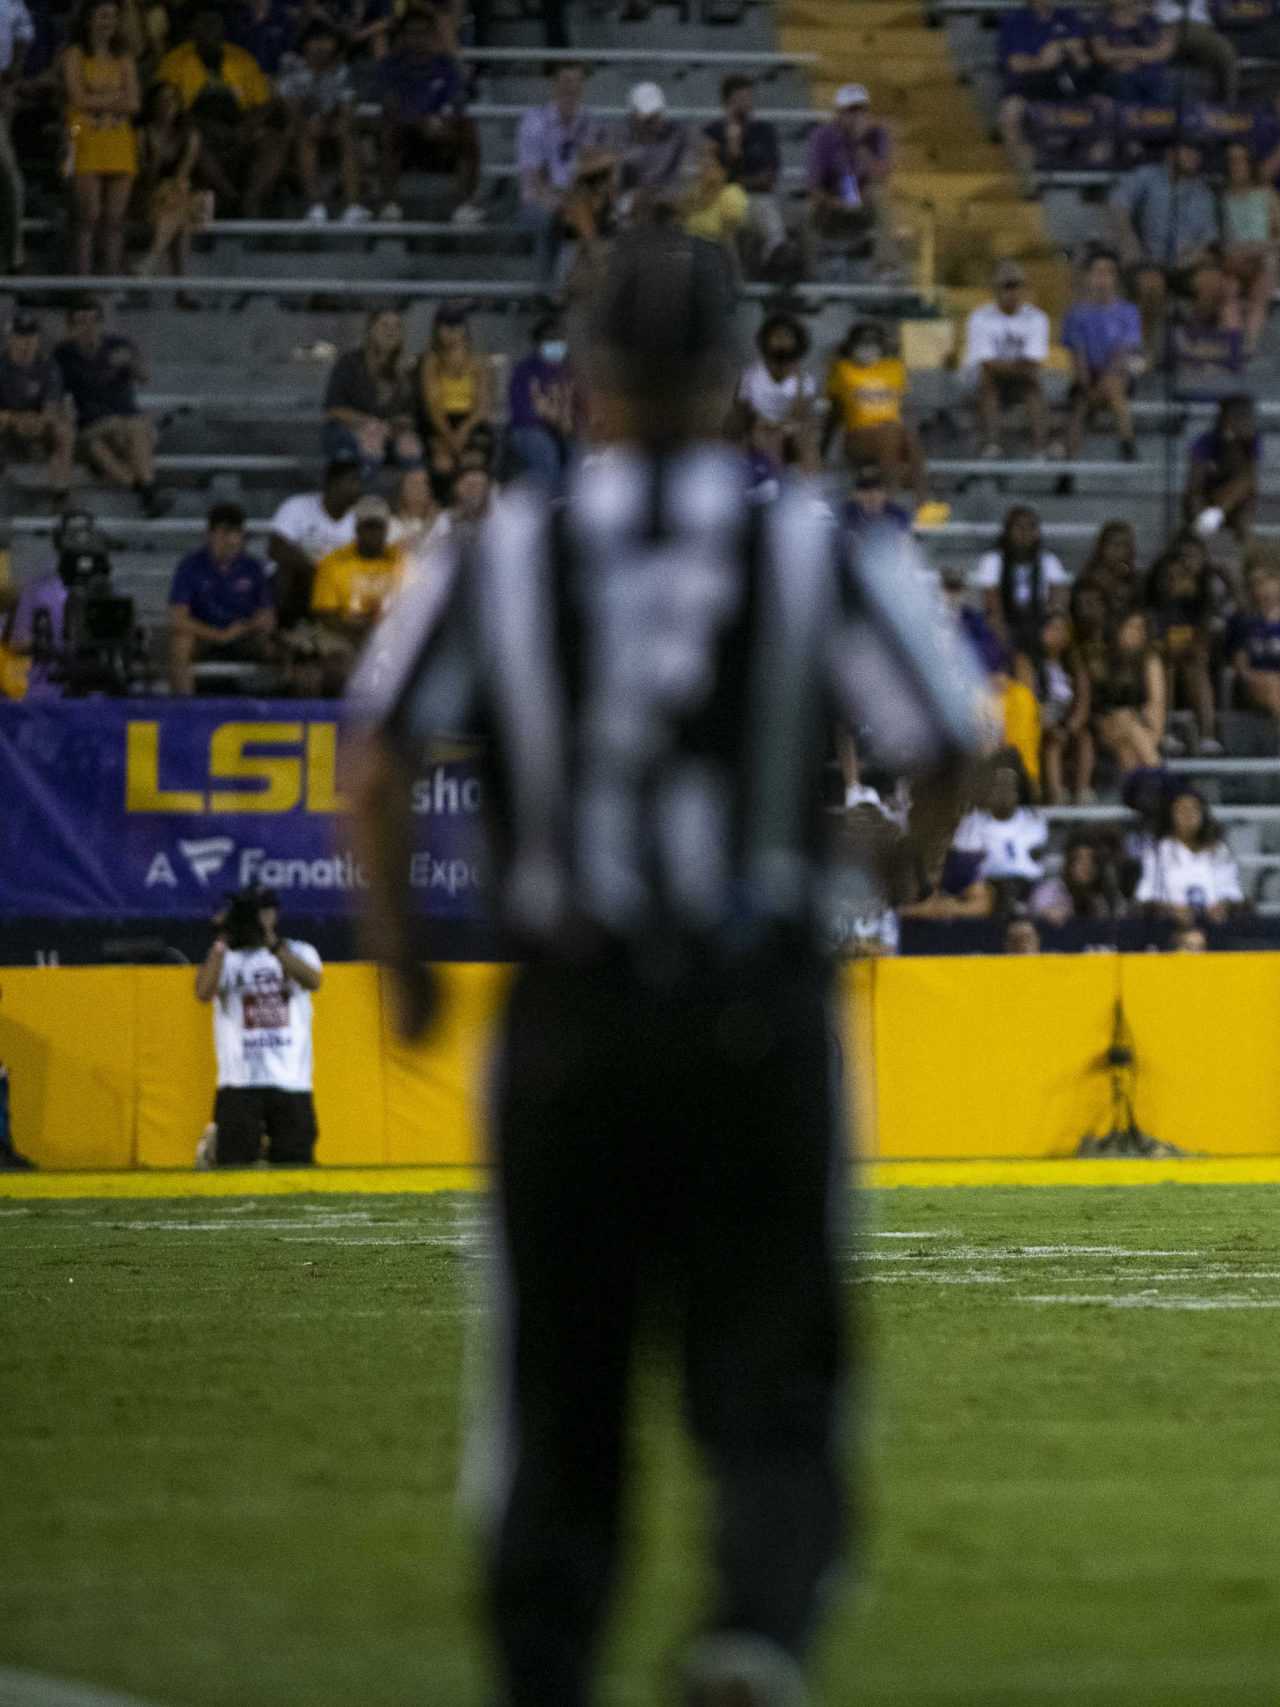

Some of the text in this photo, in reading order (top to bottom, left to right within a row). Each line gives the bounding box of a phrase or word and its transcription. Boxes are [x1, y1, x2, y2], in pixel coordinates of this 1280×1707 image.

[411, 767, 482, 816] sho
[145, 849, 481, 895] A Fanatic Exp
